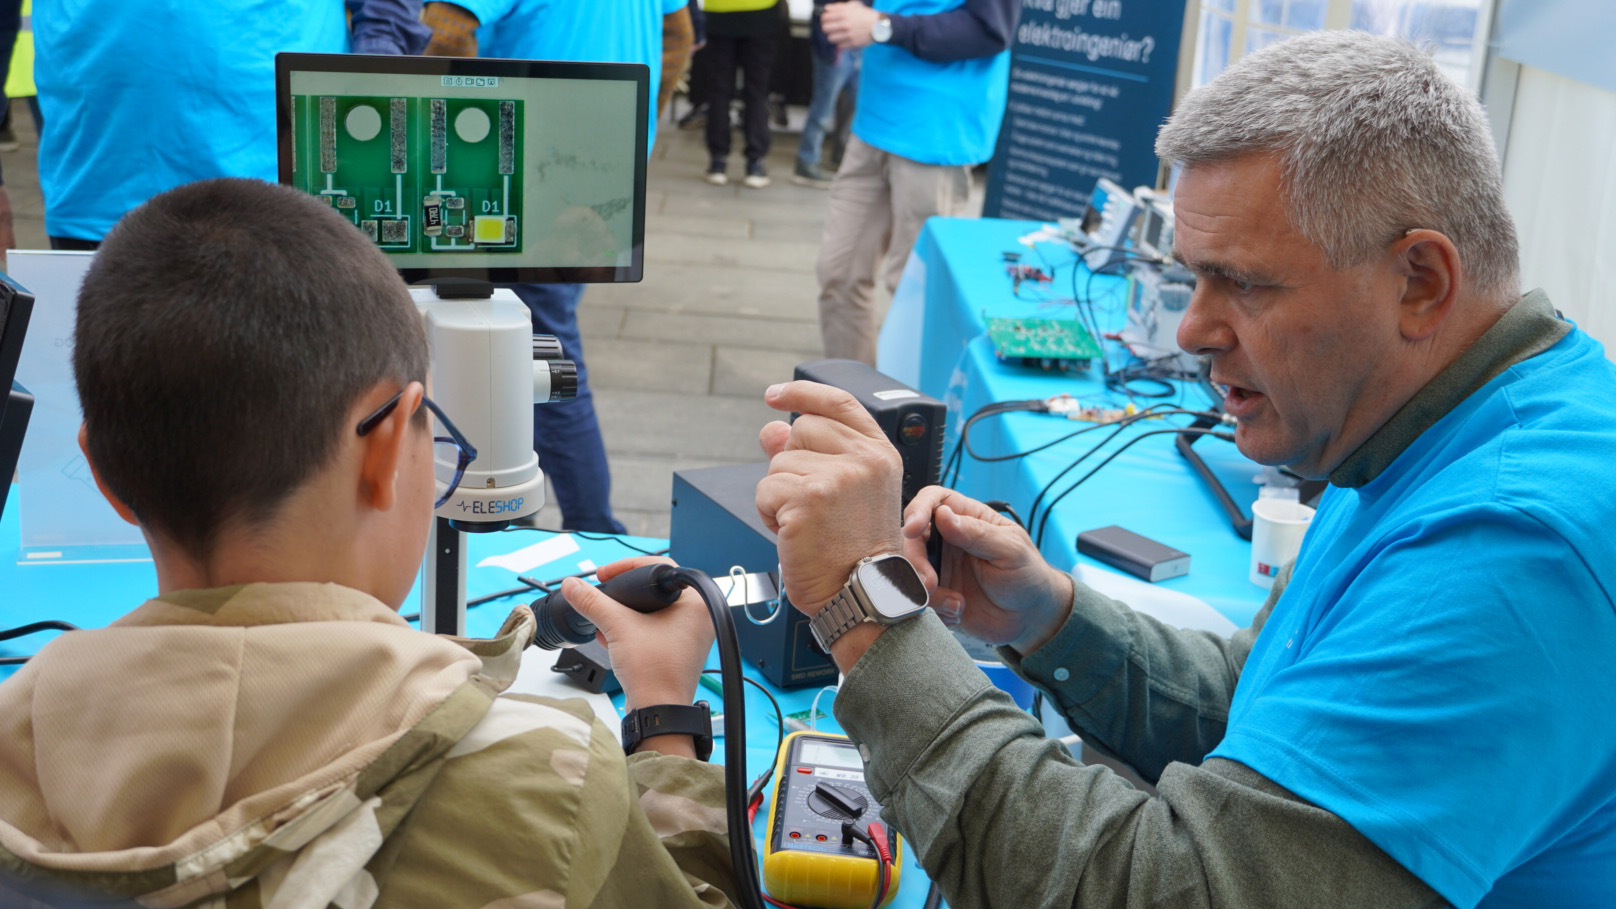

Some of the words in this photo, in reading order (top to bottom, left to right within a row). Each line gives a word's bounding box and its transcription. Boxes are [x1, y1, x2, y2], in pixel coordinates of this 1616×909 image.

[374, 200, 393, 212] D1
[482, 200, 500, 213] D1
[473, 498, 524, 513] ELESHOP
